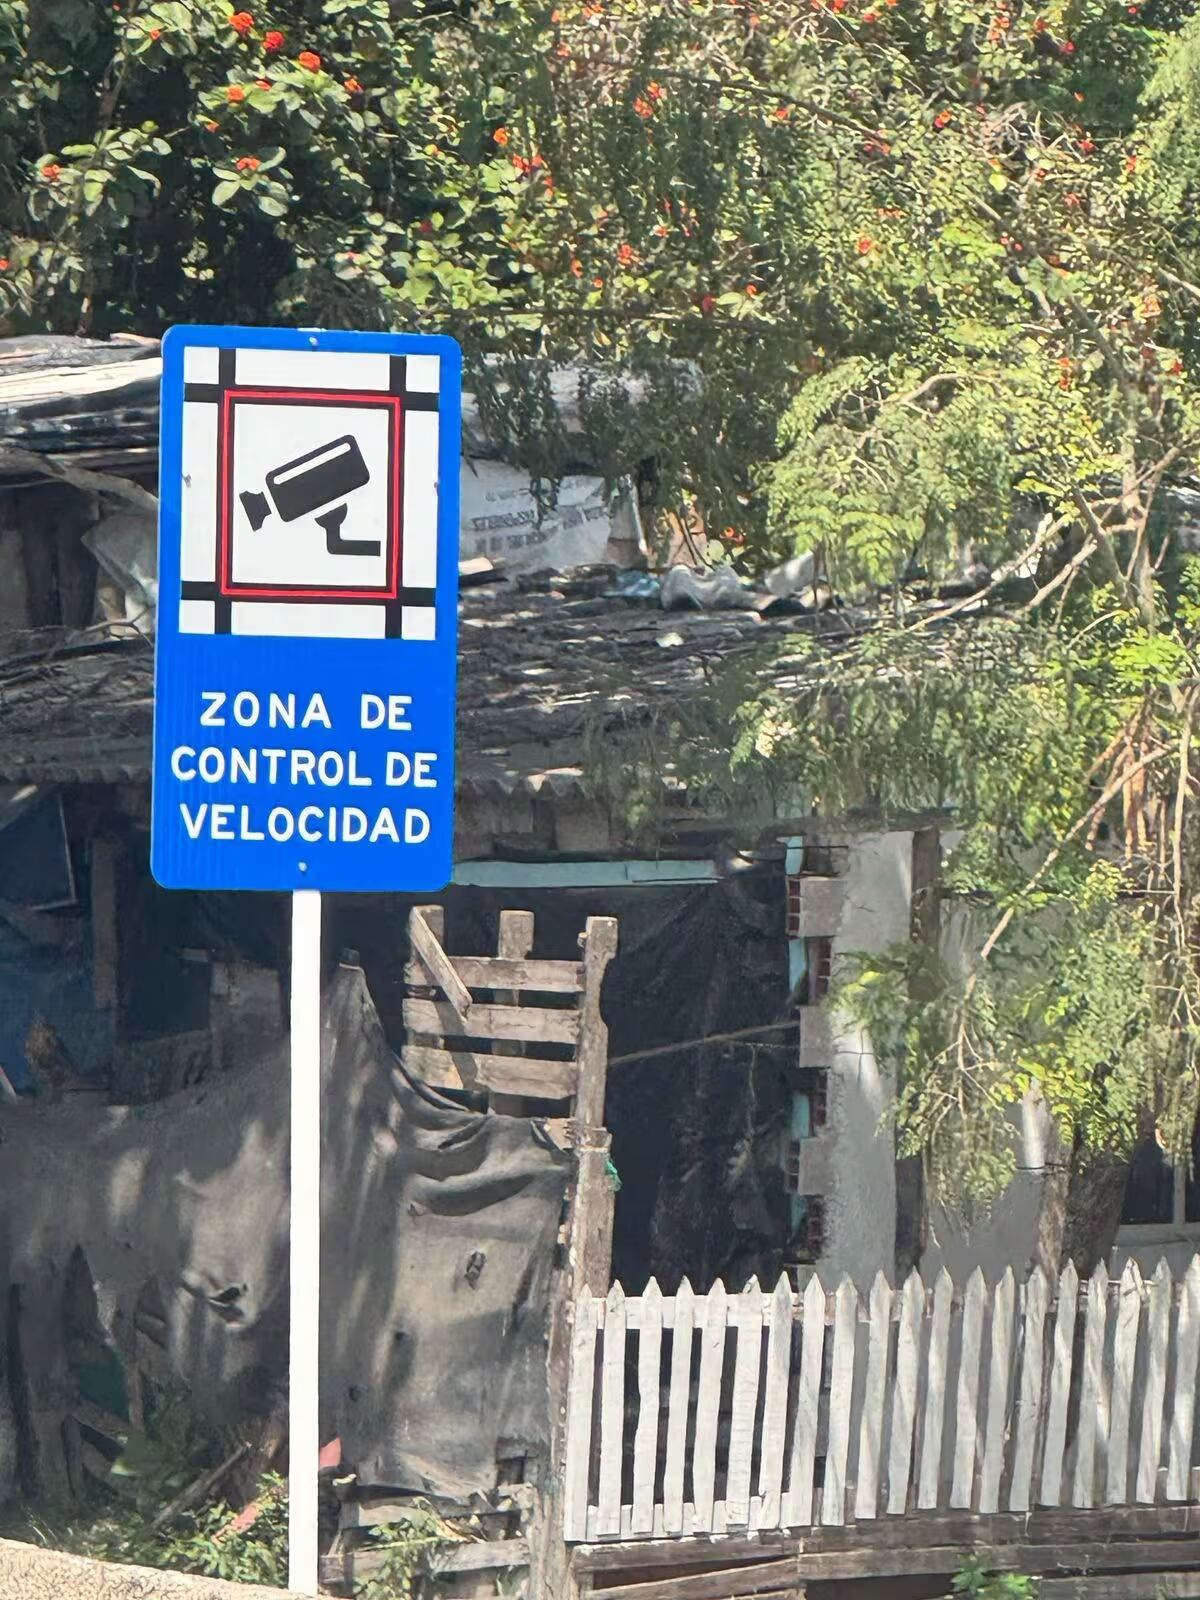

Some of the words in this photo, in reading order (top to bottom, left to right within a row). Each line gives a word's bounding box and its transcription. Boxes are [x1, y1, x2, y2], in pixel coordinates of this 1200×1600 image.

[200, 691, 332, 729] ZONA
[360, 694, 412, 731] DE
[171, 745, 372, 787] CONTROL
[385, 751, 438, 788] DE
[179, 803, 431, 844] VELOCIDAD
